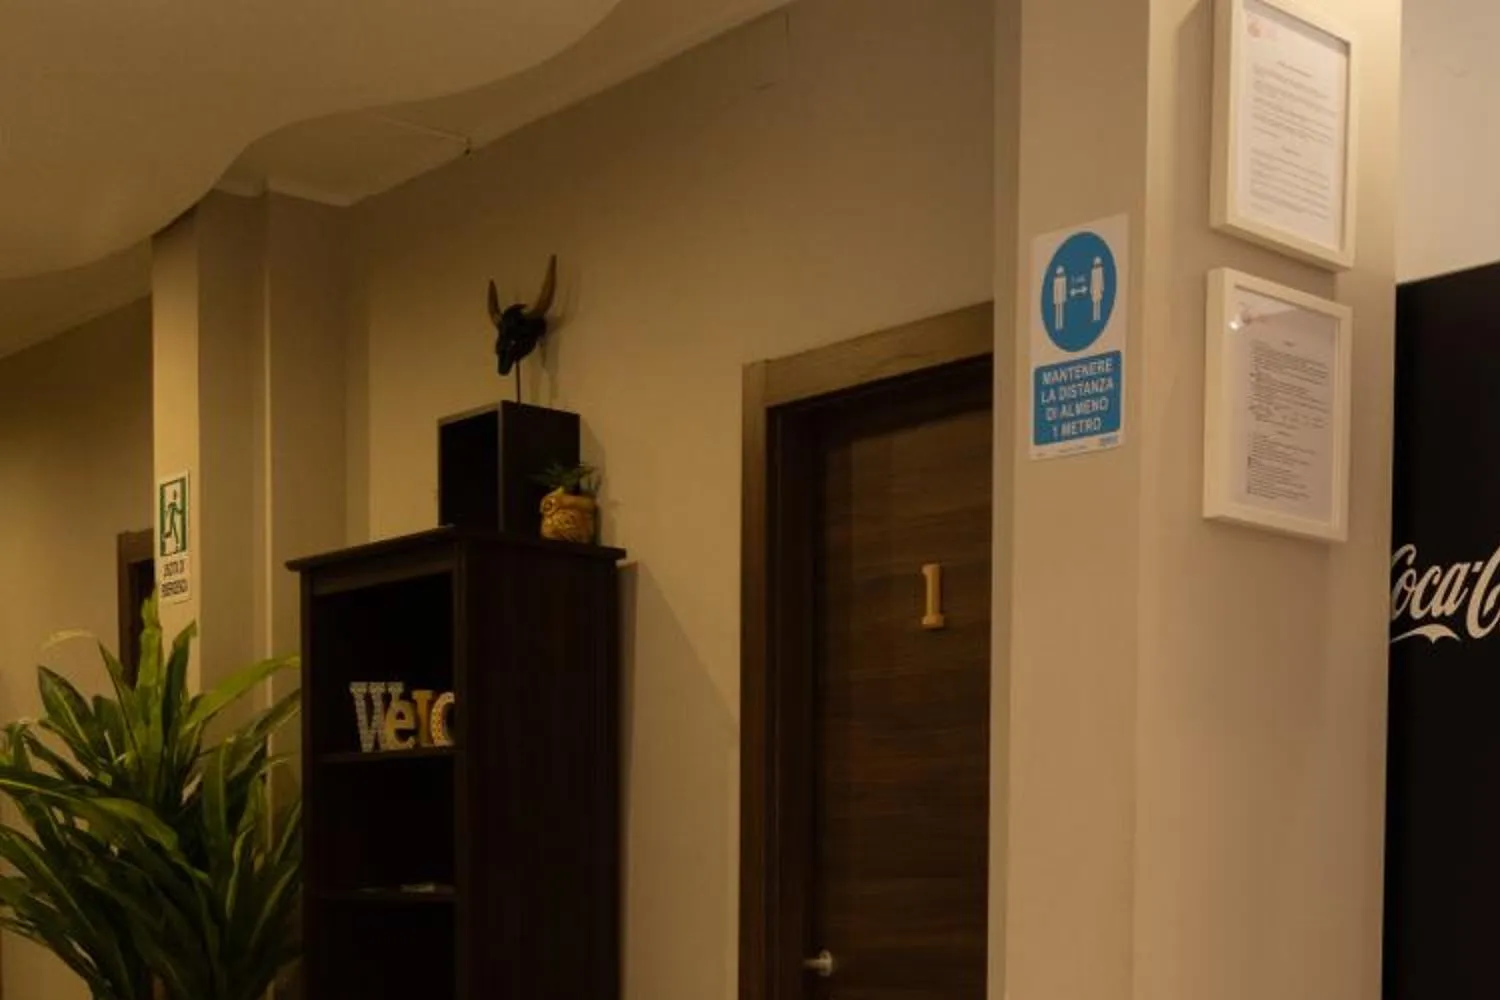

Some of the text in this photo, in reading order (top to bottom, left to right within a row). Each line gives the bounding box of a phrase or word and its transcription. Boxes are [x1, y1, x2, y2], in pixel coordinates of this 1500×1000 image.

[1042, 358, 1113, 385] MANTENERE
[1041, 377, 1113, 404] LA DISTANZA
[1060, 396, 1109, 419] ALMENO
[1060, 417, 1102, 437] METRO
